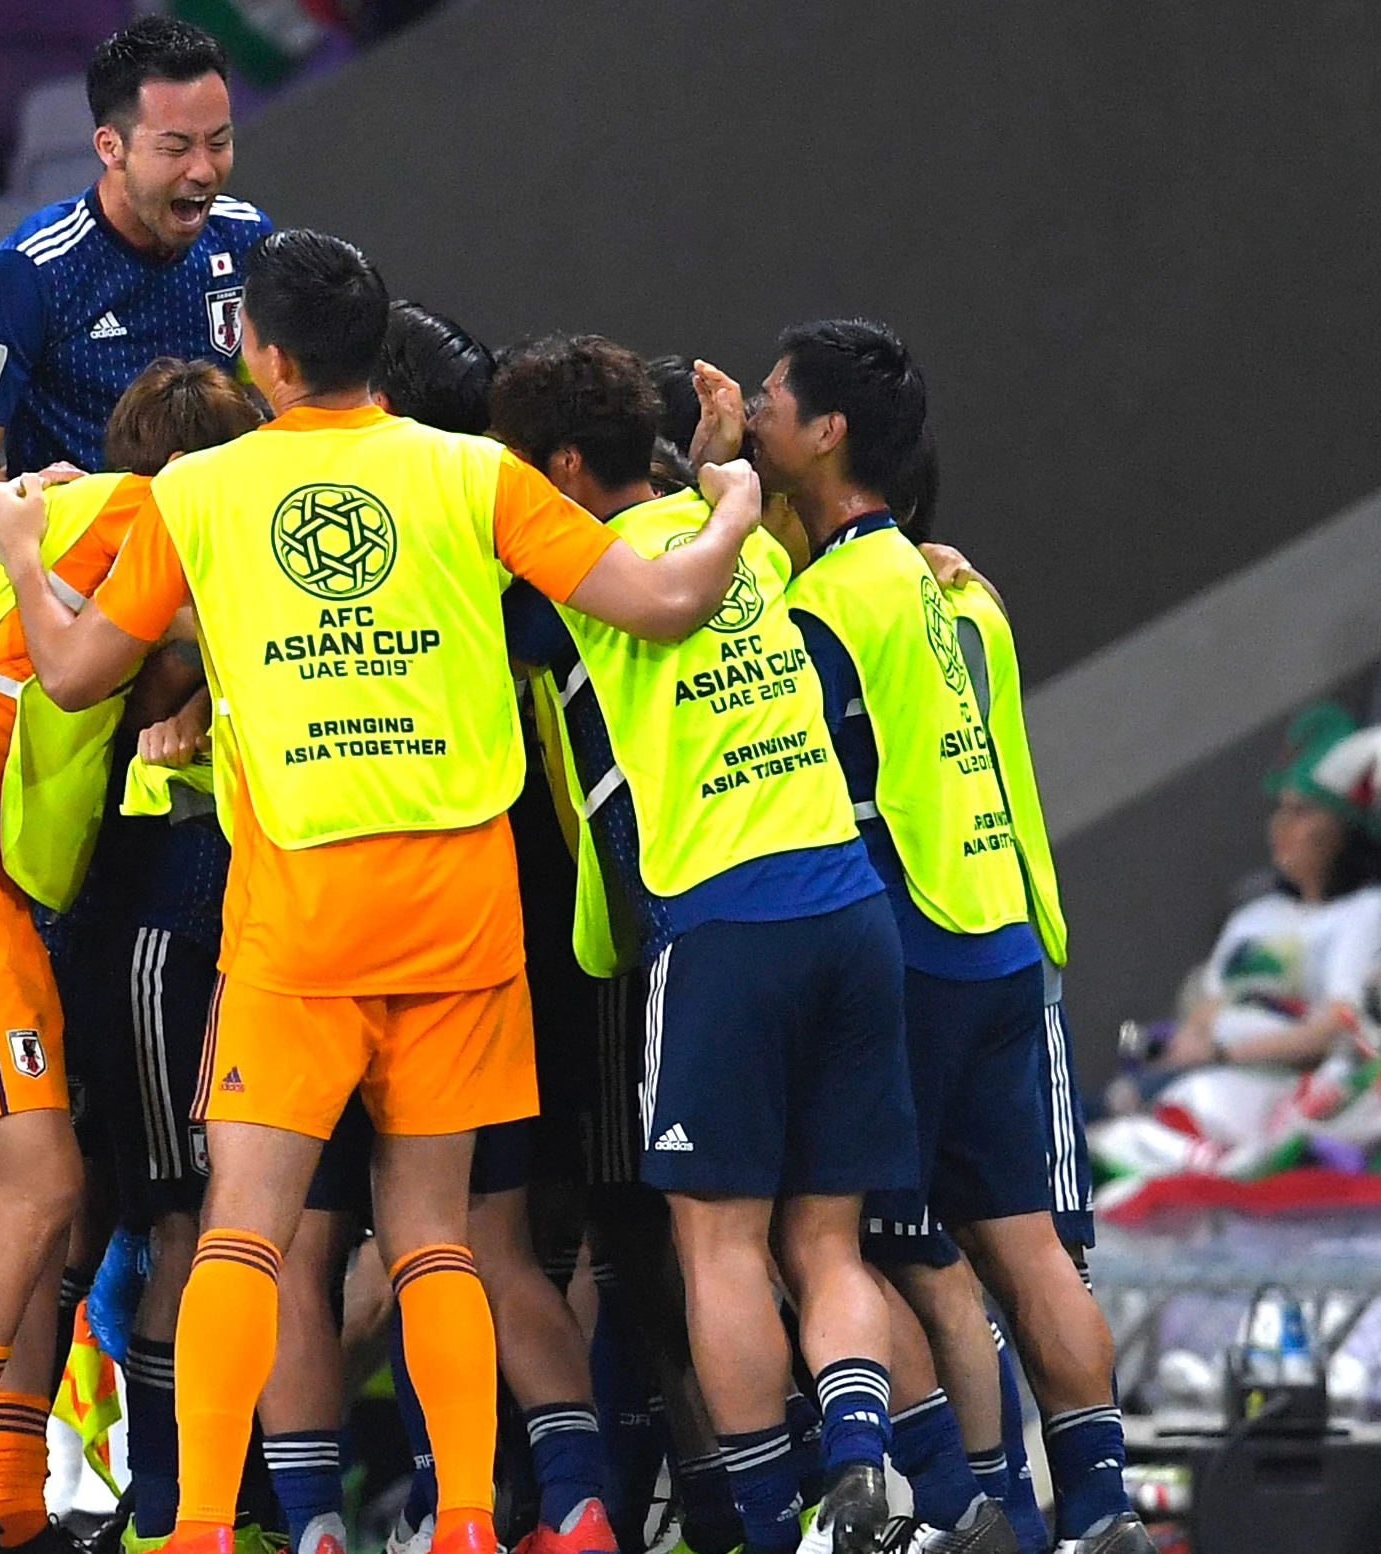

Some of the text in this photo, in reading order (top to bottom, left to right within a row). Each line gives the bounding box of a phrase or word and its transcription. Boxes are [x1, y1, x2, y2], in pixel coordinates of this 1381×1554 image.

[90, 327, 128, 339] adidas
[319, 606, 374, 628] AFC
[264, 630, 440, 665] ASIAN CUP
[721, 634, 763, 662] AFC
[299, 660, 348, 680] UAE
[675, 648, 807, 707] ASIAN CUP
[710, 689, 755, 714] UAE
[308, 717, 414, 738] BRINGING
[285, 739, 446, 765] ASIA TOGETHER
[701, 771, 751, 799] ASIA
[655, 1140, 694, 1152] adidas
